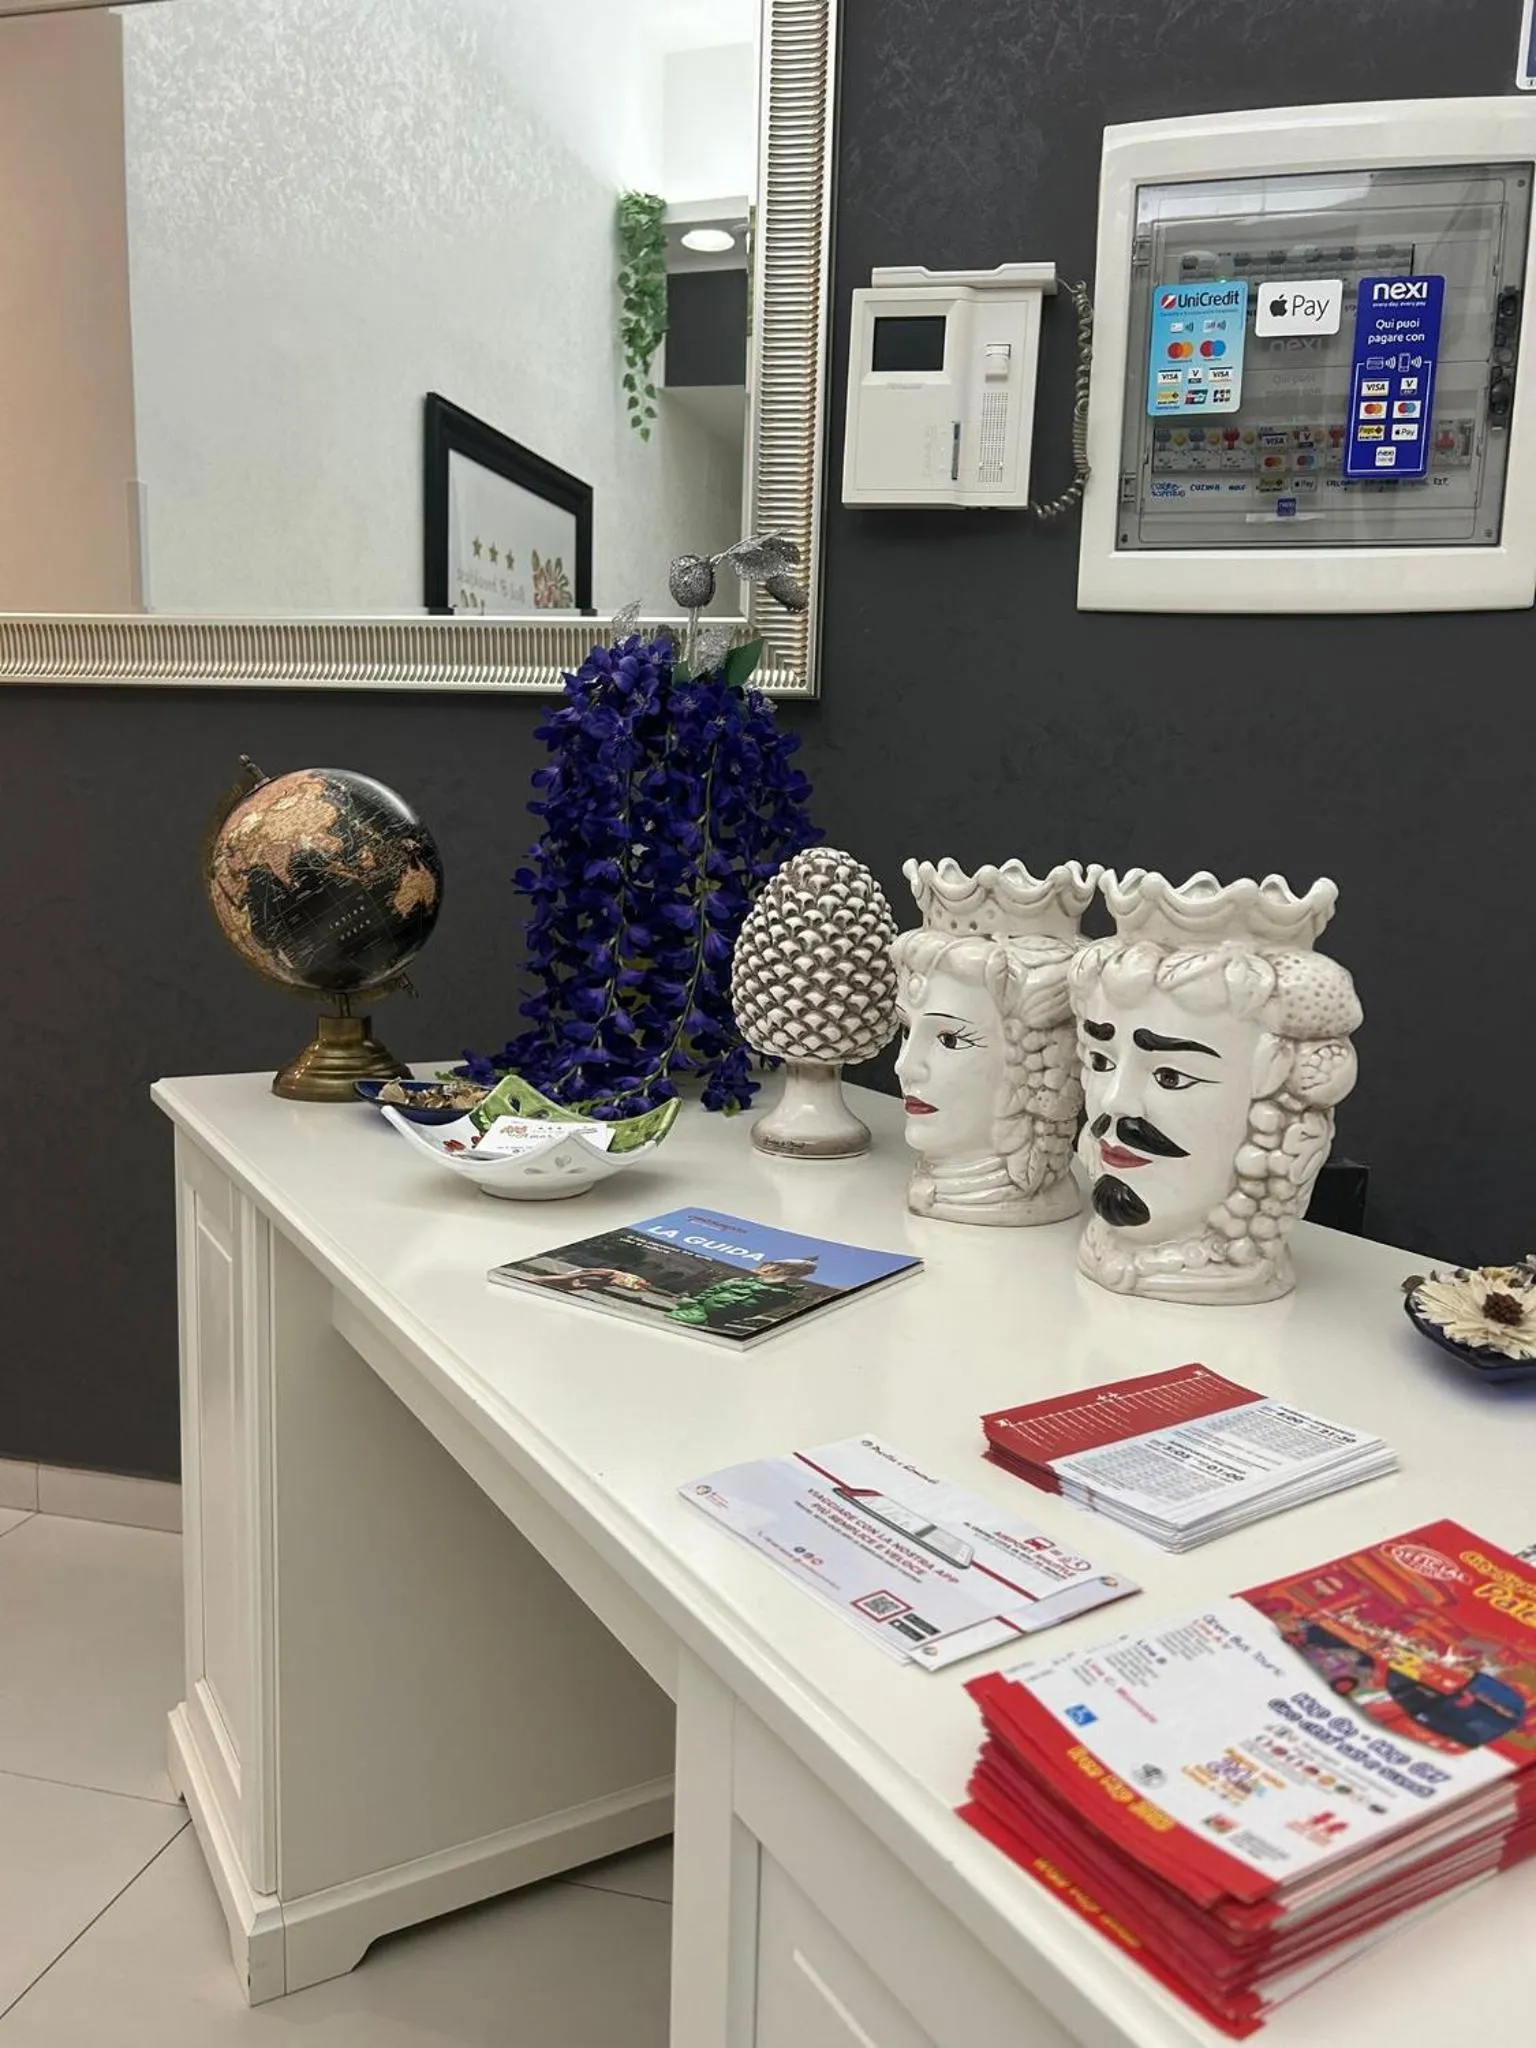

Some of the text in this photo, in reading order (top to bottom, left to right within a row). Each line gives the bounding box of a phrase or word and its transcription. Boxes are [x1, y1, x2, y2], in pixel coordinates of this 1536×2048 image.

[1178, 290, 1240, 308] UniCredit
[1373, 282, 1428, 300] nexi
[1292, 294, 1330, 321] Pay
[1375, 318, 1420, 331] Qui puoi
[1368, 333, 1425, 345] pagare con
[1366, 383, 1385, 391] VISA
[648, 1225, 680, 1239] LA
[683, 1236, 766, 1261] GUIDA
